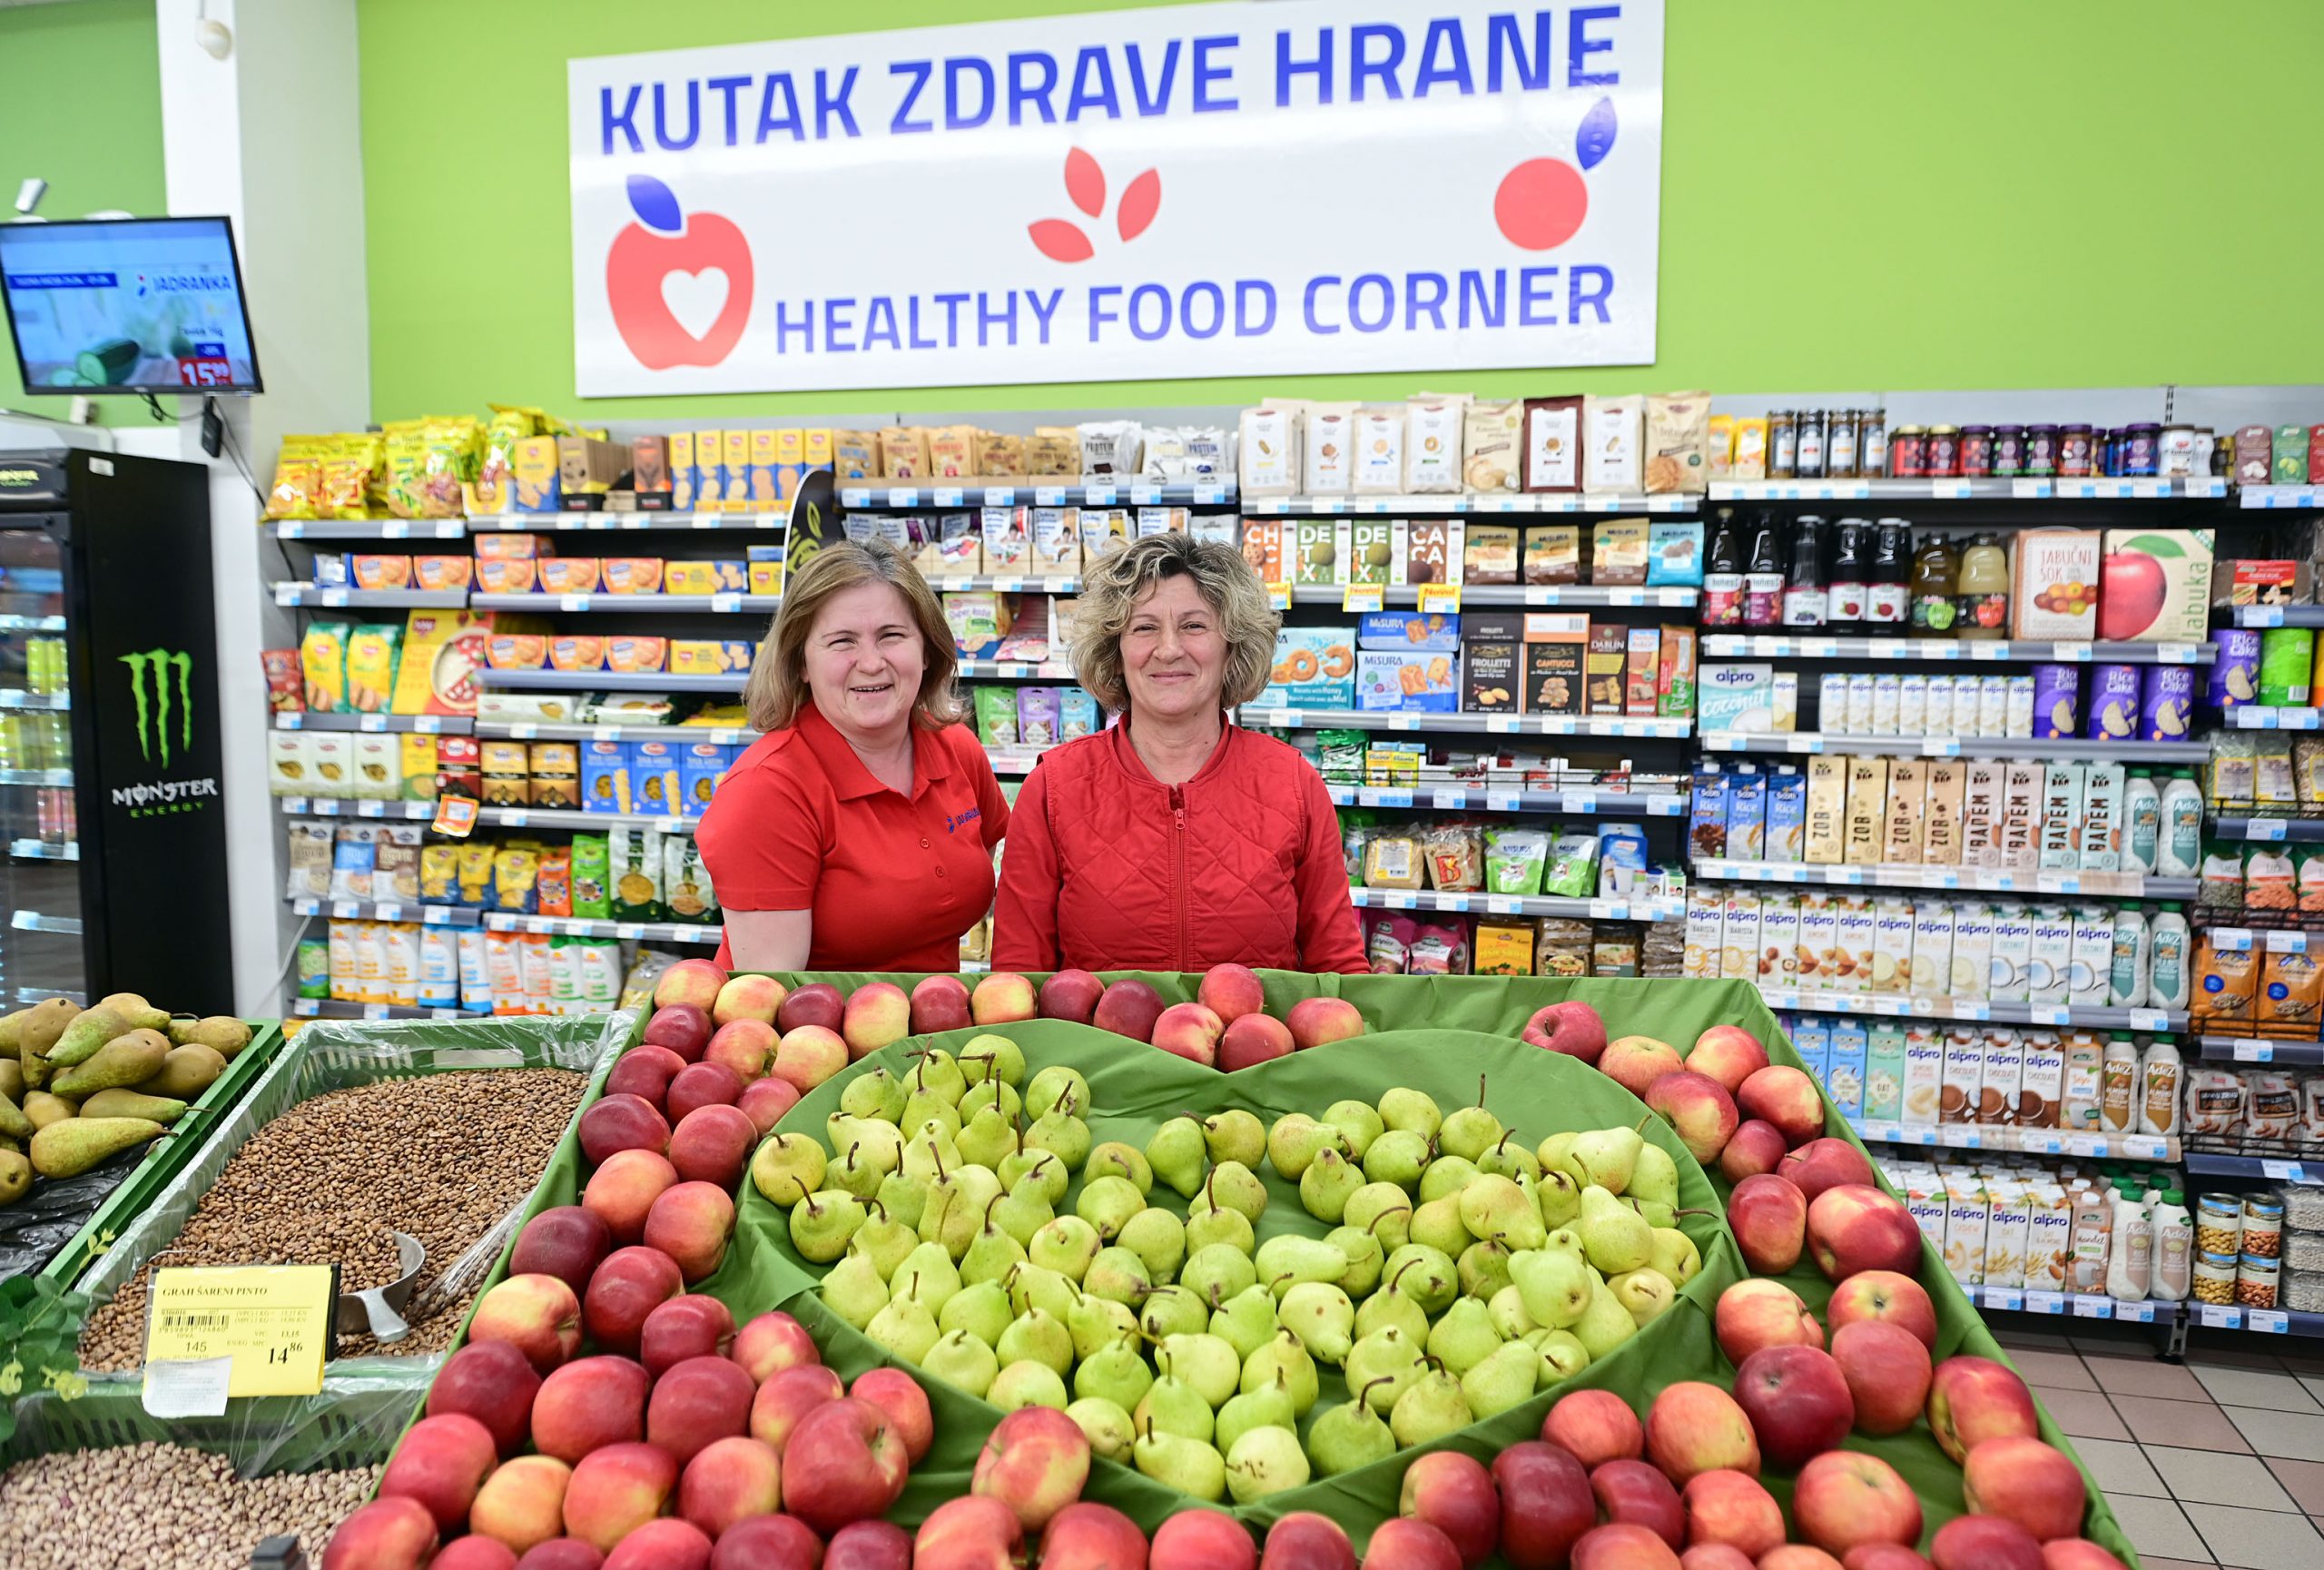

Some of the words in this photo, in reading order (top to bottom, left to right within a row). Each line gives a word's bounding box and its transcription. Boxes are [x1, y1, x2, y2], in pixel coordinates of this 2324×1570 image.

[600, 65, 862, 156] KUTAK
[888, 33, 1241, 135] ZDRAVE
[1275, 4, 1621, 107] HRANE
[153, 274, 231, 293] JADRANKA
[775, 288, 1065, 354] HEALTHY
[1088, 279, 1278, 342] FOOD
[1303, 263, 1615, 335] CORNER
[1300, 526, 1332, 544] DE
[1355, 526, 1388, 544] DE
[2041, 546, 2092, 566] JABUČNI
[2041, 567, 2063, 582] SOK
[1716, 668, 1755, 685] alpro
[2108, 670, 2135, 683] Rice
[2162, 669, 2190, 681] Rice
[2106, 681, 2135, 693] Cake
[2161, 680, 2189, 693] Cake
[1699, 690, 1765, 717] coconut
[112, 778, 218, 806] MONSTER
[130, 801, 204, 818] ENERGY
[1689, 909, 1720, 924] alpro
[1727, 910, 1758, 924] alpro
[1765, 911, 1797, 925] alpro
[1803, 912, 1835, 927] alpro
[1840, 913, 1872, 928] alpro
[1878, 915, 1911, 931] alpro
[1917, 919, 1950, 935] alpro
[1957, 921, 1991, 936] alpro
[1995, 922, 2029, 937] alpro
[2035, 924, 2069, 941] alpro
[2076, 926, 2111, 942] alpro
[1907, 1046, 1940, 1061] alpro
[1948, 1049, 1981, 1063] alpro
[1986, 1052, 2020, 1065] alpro
[2026, 1054, 2060, 1069] alpro
[2105, 1061, 2133, 1075] AdeZ
[2148, 1063, 2177, 1078] AdeZ
[1910, 1204, 1944, 1218] alpro
[1952, 1207, 1984, 1220] alpro
[1992, 1210, 2026, 1224] alpro
[2034, 1213, 2068, 1228] alpro
[197, 1287, 234, 1296] ŠARENI
[236, 1288, 268, 1296] PINTO
[185, 1341, 207, 1352] 145
